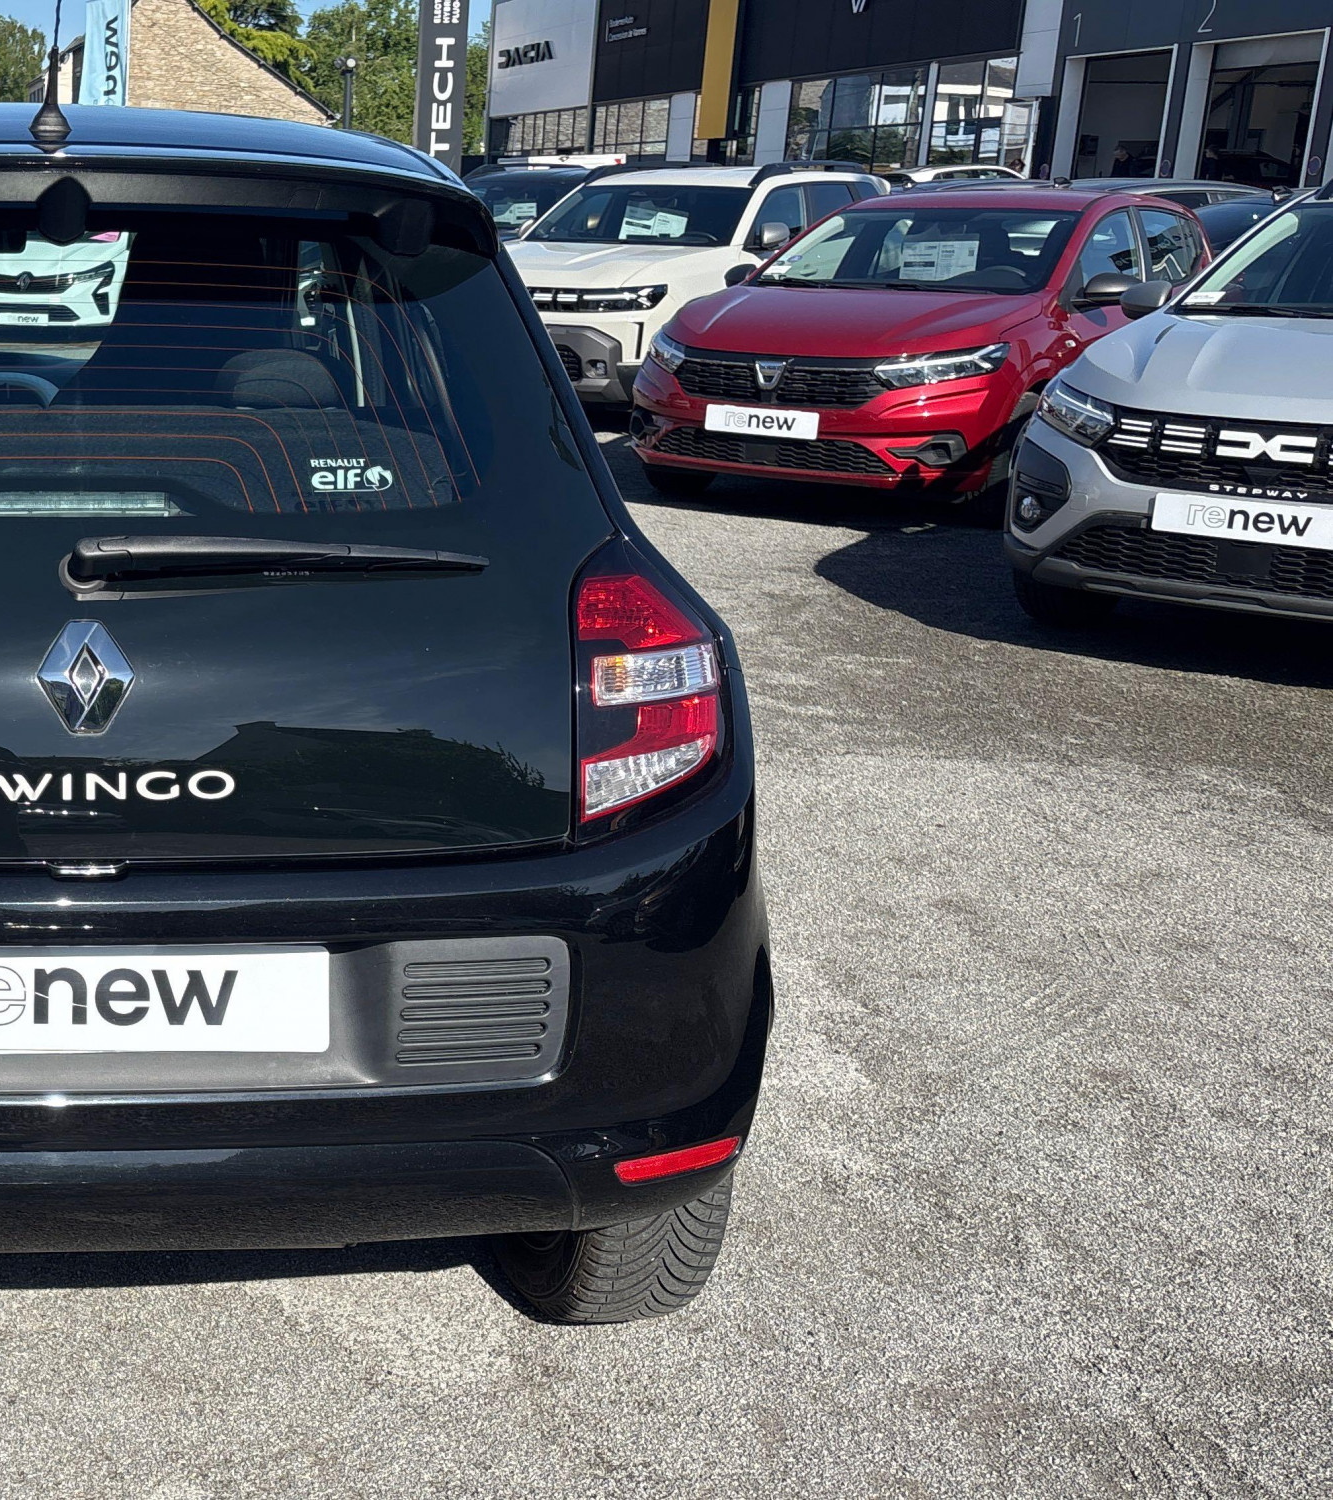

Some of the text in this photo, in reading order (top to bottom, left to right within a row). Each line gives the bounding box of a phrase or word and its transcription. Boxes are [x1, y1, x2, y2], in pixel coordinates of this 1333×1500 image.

[1073, 13, 1082, 47] 1
[429, 37, 456, 158] TECH
[725, 411, 796, 431] renew
[310, 458, 366, 468] RENAULT
[311, 469, 361, 490] elf
[1209, 483, 1308, 499] STEPWAY
[1186, 504, 1313, 537] renew
